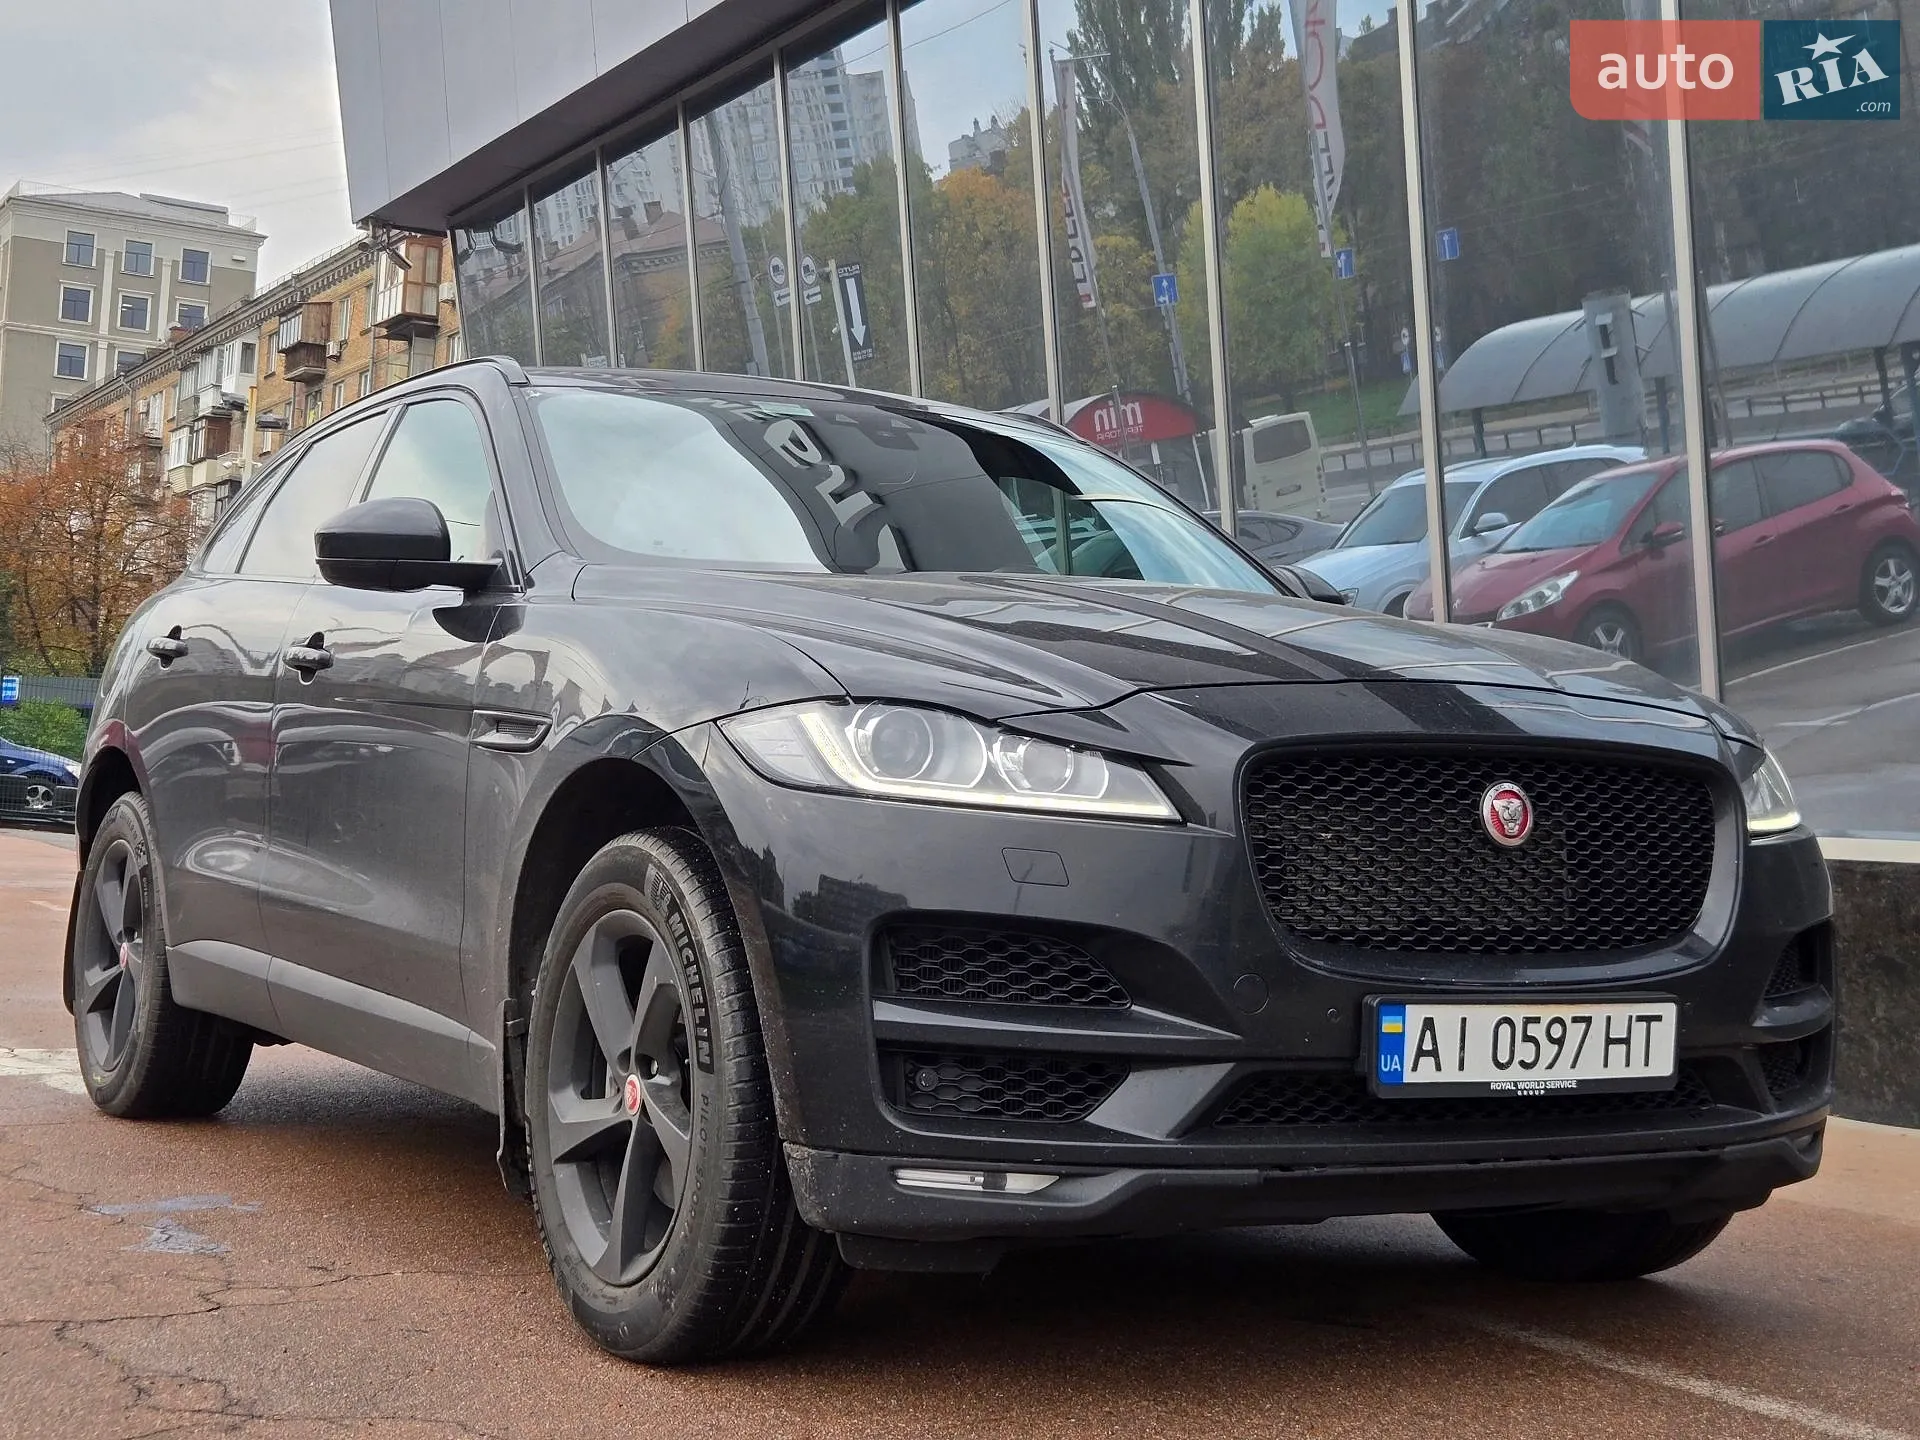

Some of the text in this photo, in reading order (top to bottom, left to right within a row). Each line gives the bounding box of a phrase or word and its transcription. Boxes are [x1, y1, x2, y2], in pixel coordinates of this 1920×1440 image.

[668, 911, 711, 1065] MICHELIN
[1491, 1015, 1593, 1070] 0597
[1603, 1014, 1663, 1069] HT
[1381, 1054, 1401, 1072] UA
[1490, 1079, 1578, 1090] ROYAL WORLD SERVICE
